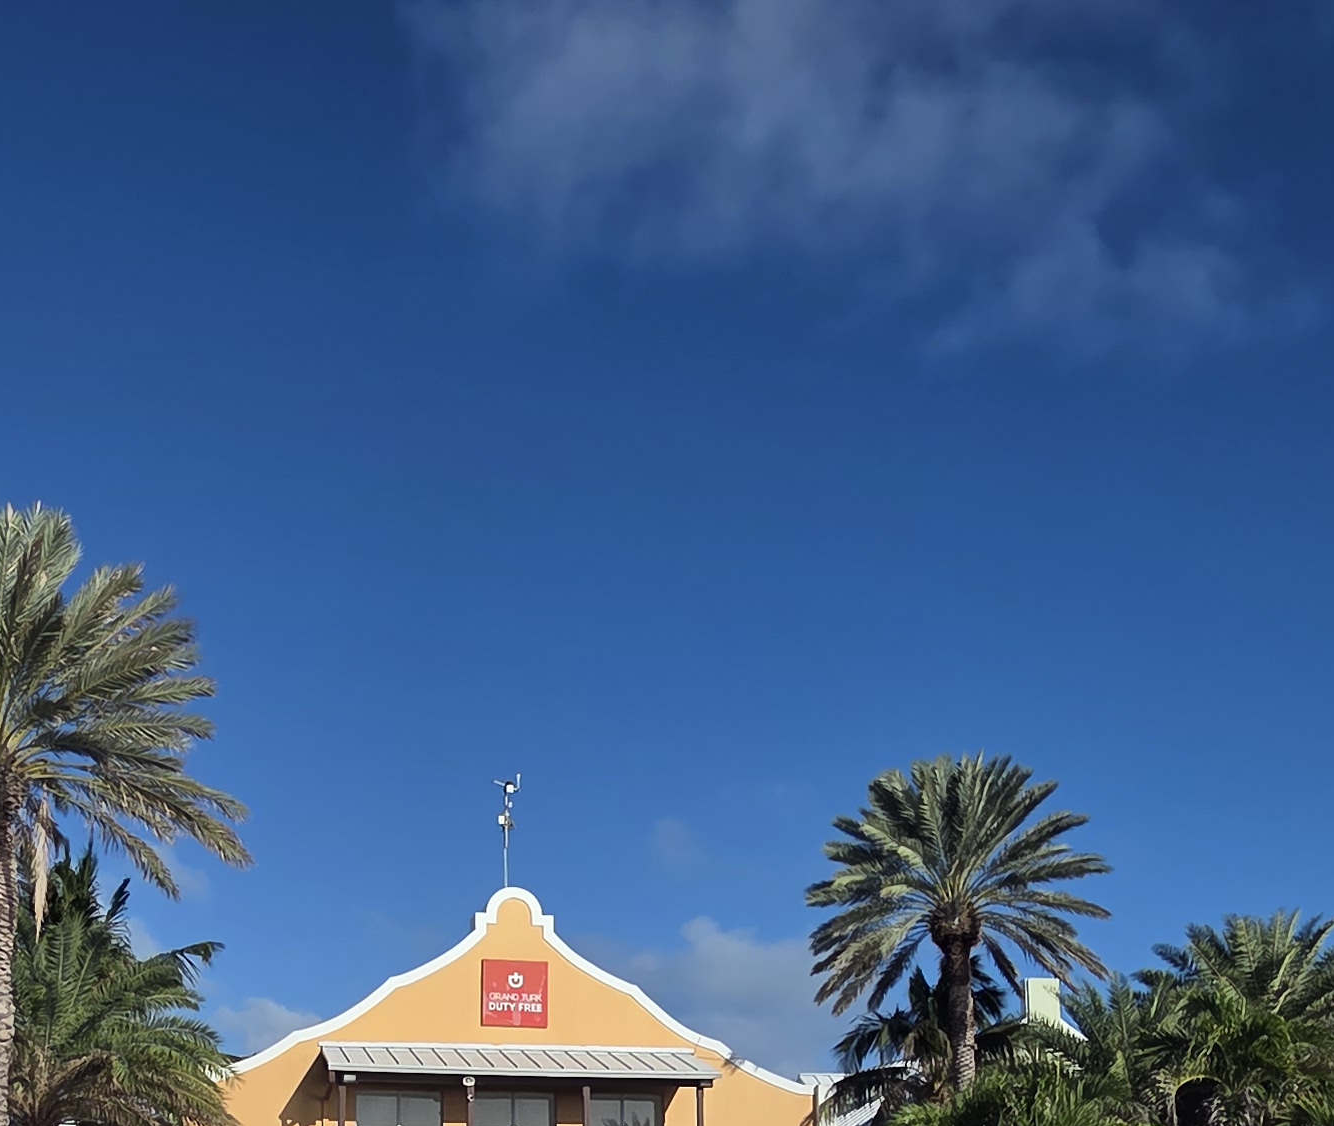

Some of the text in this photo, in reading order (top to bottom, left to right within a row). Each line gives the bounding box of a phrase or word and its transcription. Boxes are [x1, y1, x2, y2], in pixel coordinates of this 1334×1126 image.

[488, 992, 543, 1003] GRAND TURK
[488, 1002, 543, 1013] DUTY FREE
